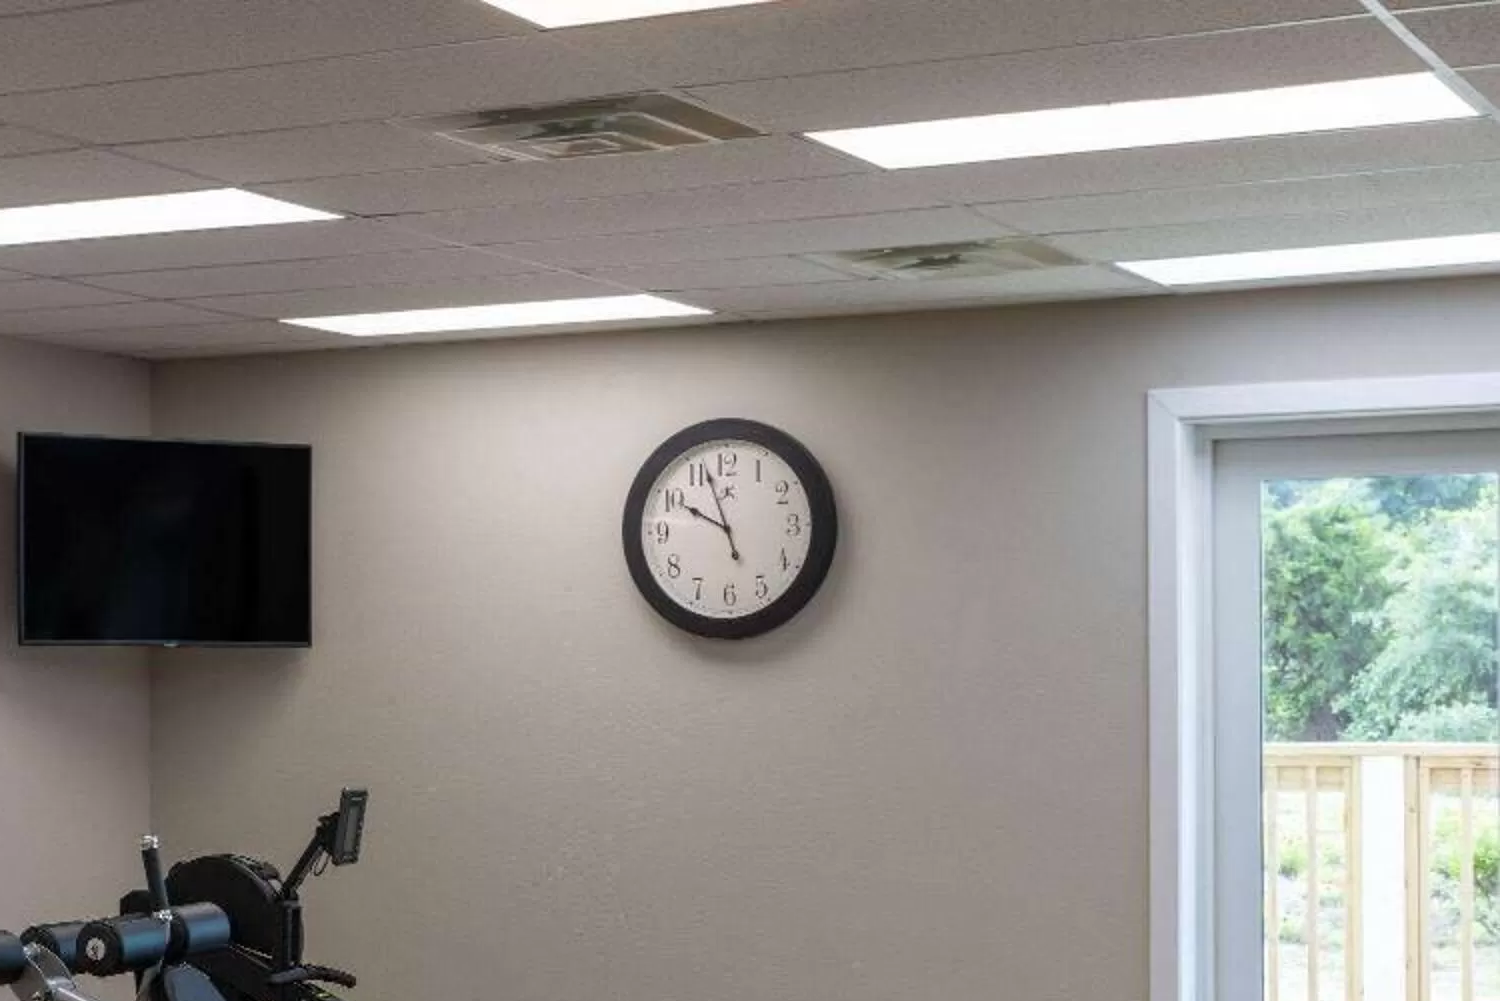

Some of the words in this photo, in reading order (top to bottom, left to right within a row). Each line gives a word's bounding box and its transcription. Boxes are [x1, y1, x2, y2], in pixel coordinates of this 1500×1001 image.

[689, 463, 704, 487] 11
[717, 452, 738, 477] 12
[755, 459, 762, 483] 1
[665, 488, 685, 512] 10
[775, 480, 790, 505] 2
[656, 520, 670, 545] 9
[787, 513, 802, 537] 3
[667, 553, 682, 579] 8
[778, 547, 791, 573] 4
[691, 577, 704, 601] 7
[723, 583, 737, 606] 6
[755, 575, 769, 599] 5
